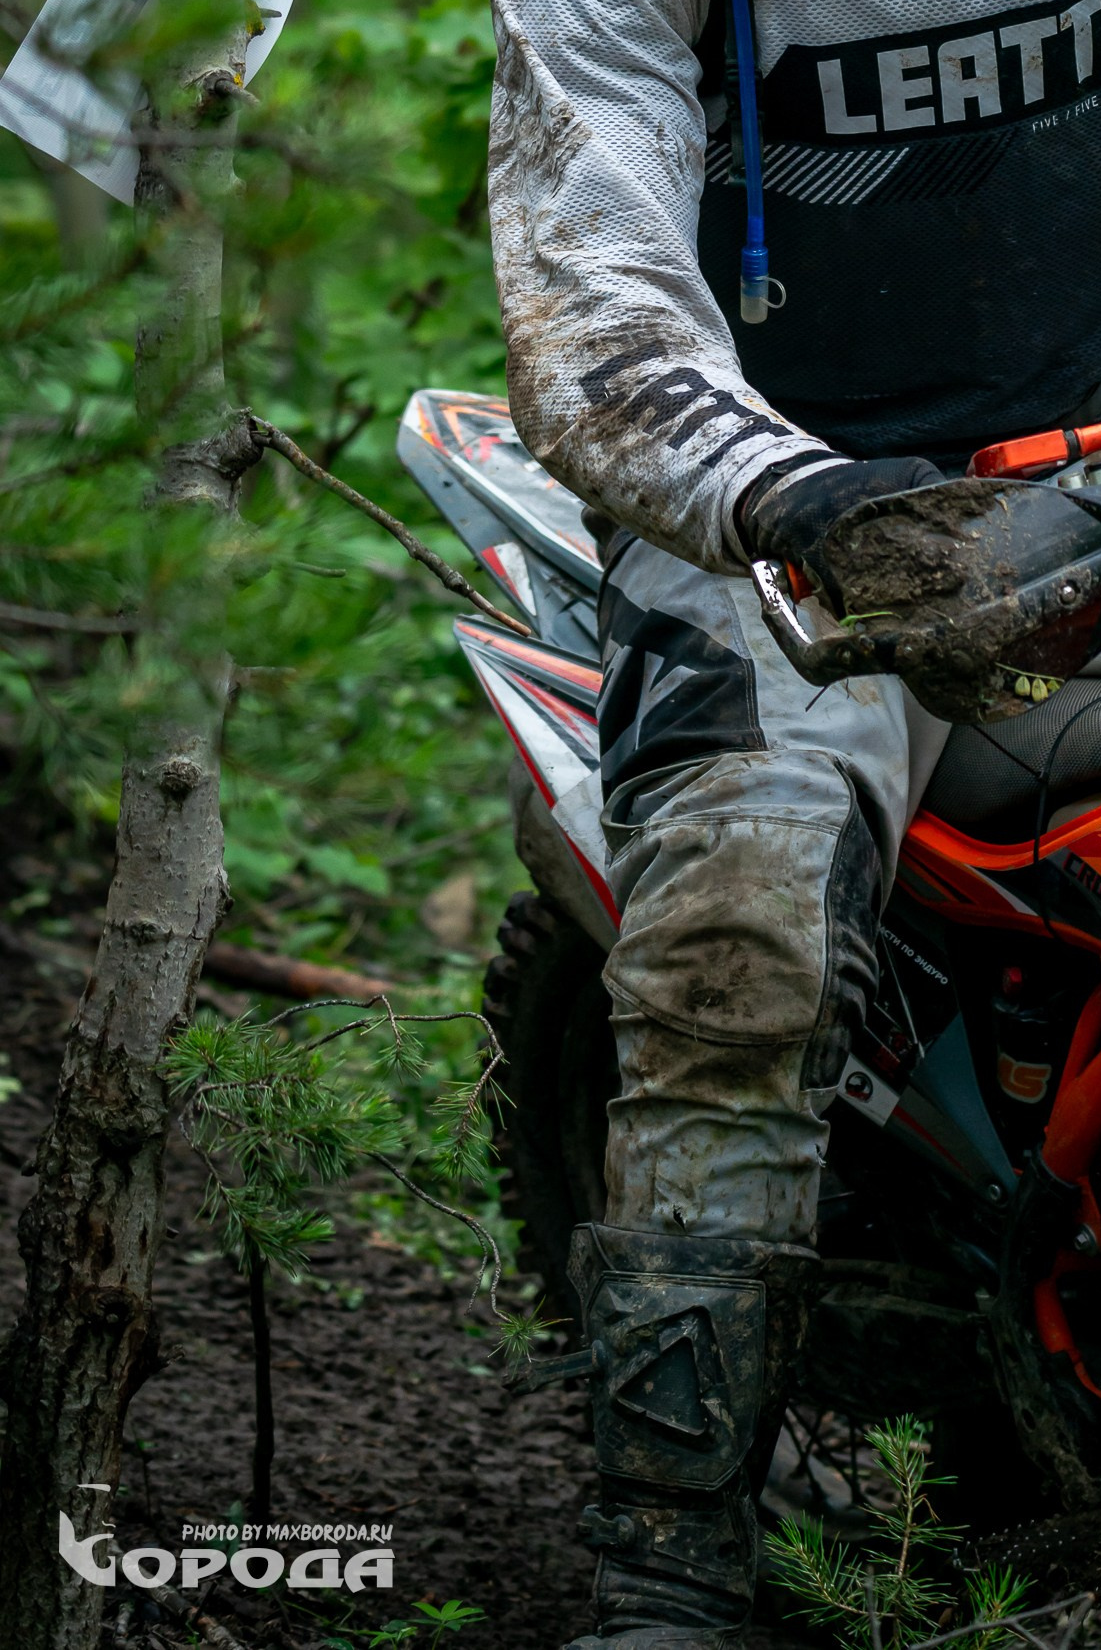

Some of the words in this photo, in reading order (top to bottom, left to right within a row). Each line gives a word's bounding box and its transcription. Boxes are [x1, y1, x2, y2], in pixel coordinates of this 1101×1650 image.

[1032, 113, 1059, 134] FIVE
[1075, 95, 1100, 117] FIVE
[577, 340, 795, 469] LATT
[901, 944, 915, 957] ПО
[914, 955, 949, 985] ЭНДУРО
